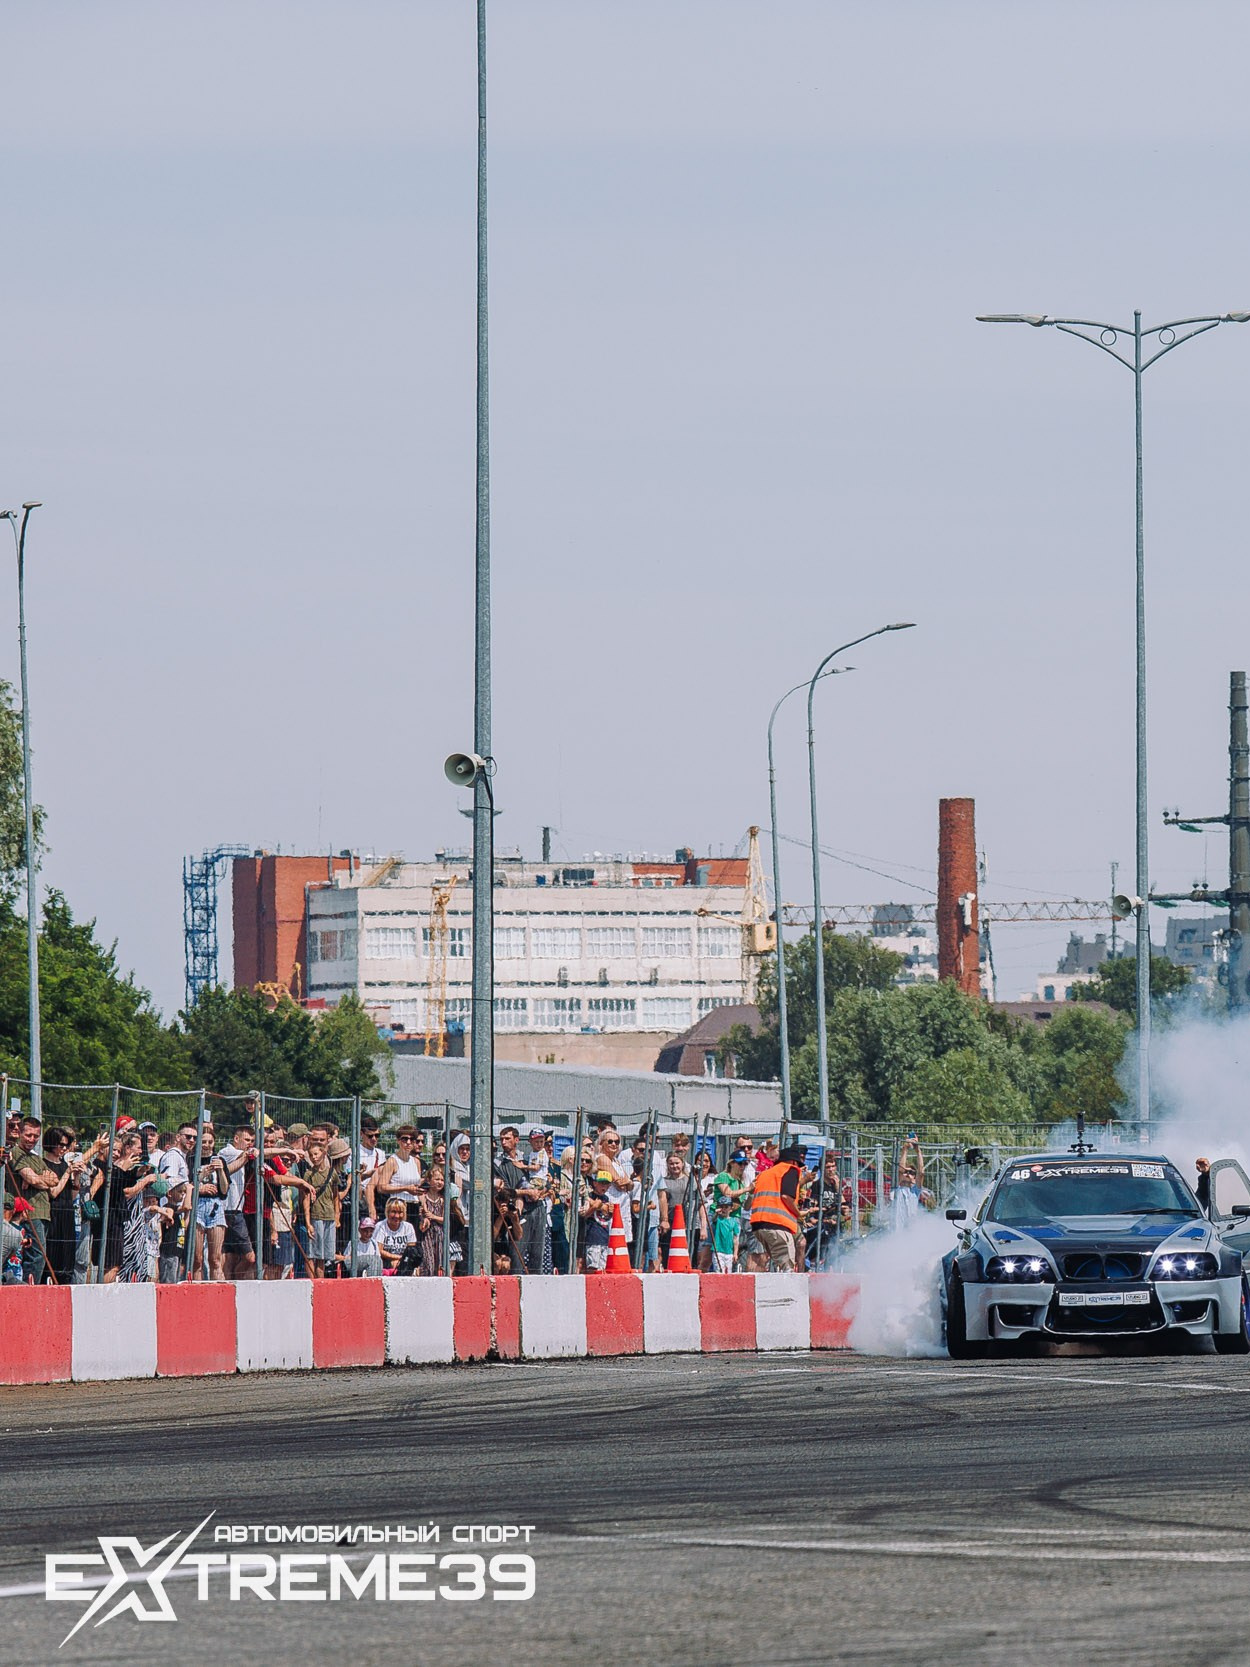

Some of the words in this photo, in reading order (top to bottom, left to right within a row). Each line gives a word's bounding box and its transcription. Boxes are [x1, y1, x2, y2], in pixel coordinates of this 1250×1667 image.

[1011, 1169, 1031, 1180] 46
[1036, 1166, 1129, 1180] EXTREME39
[383, 1235, 391, 1244] IF
[391, 1235, 408, 1245] YOU
